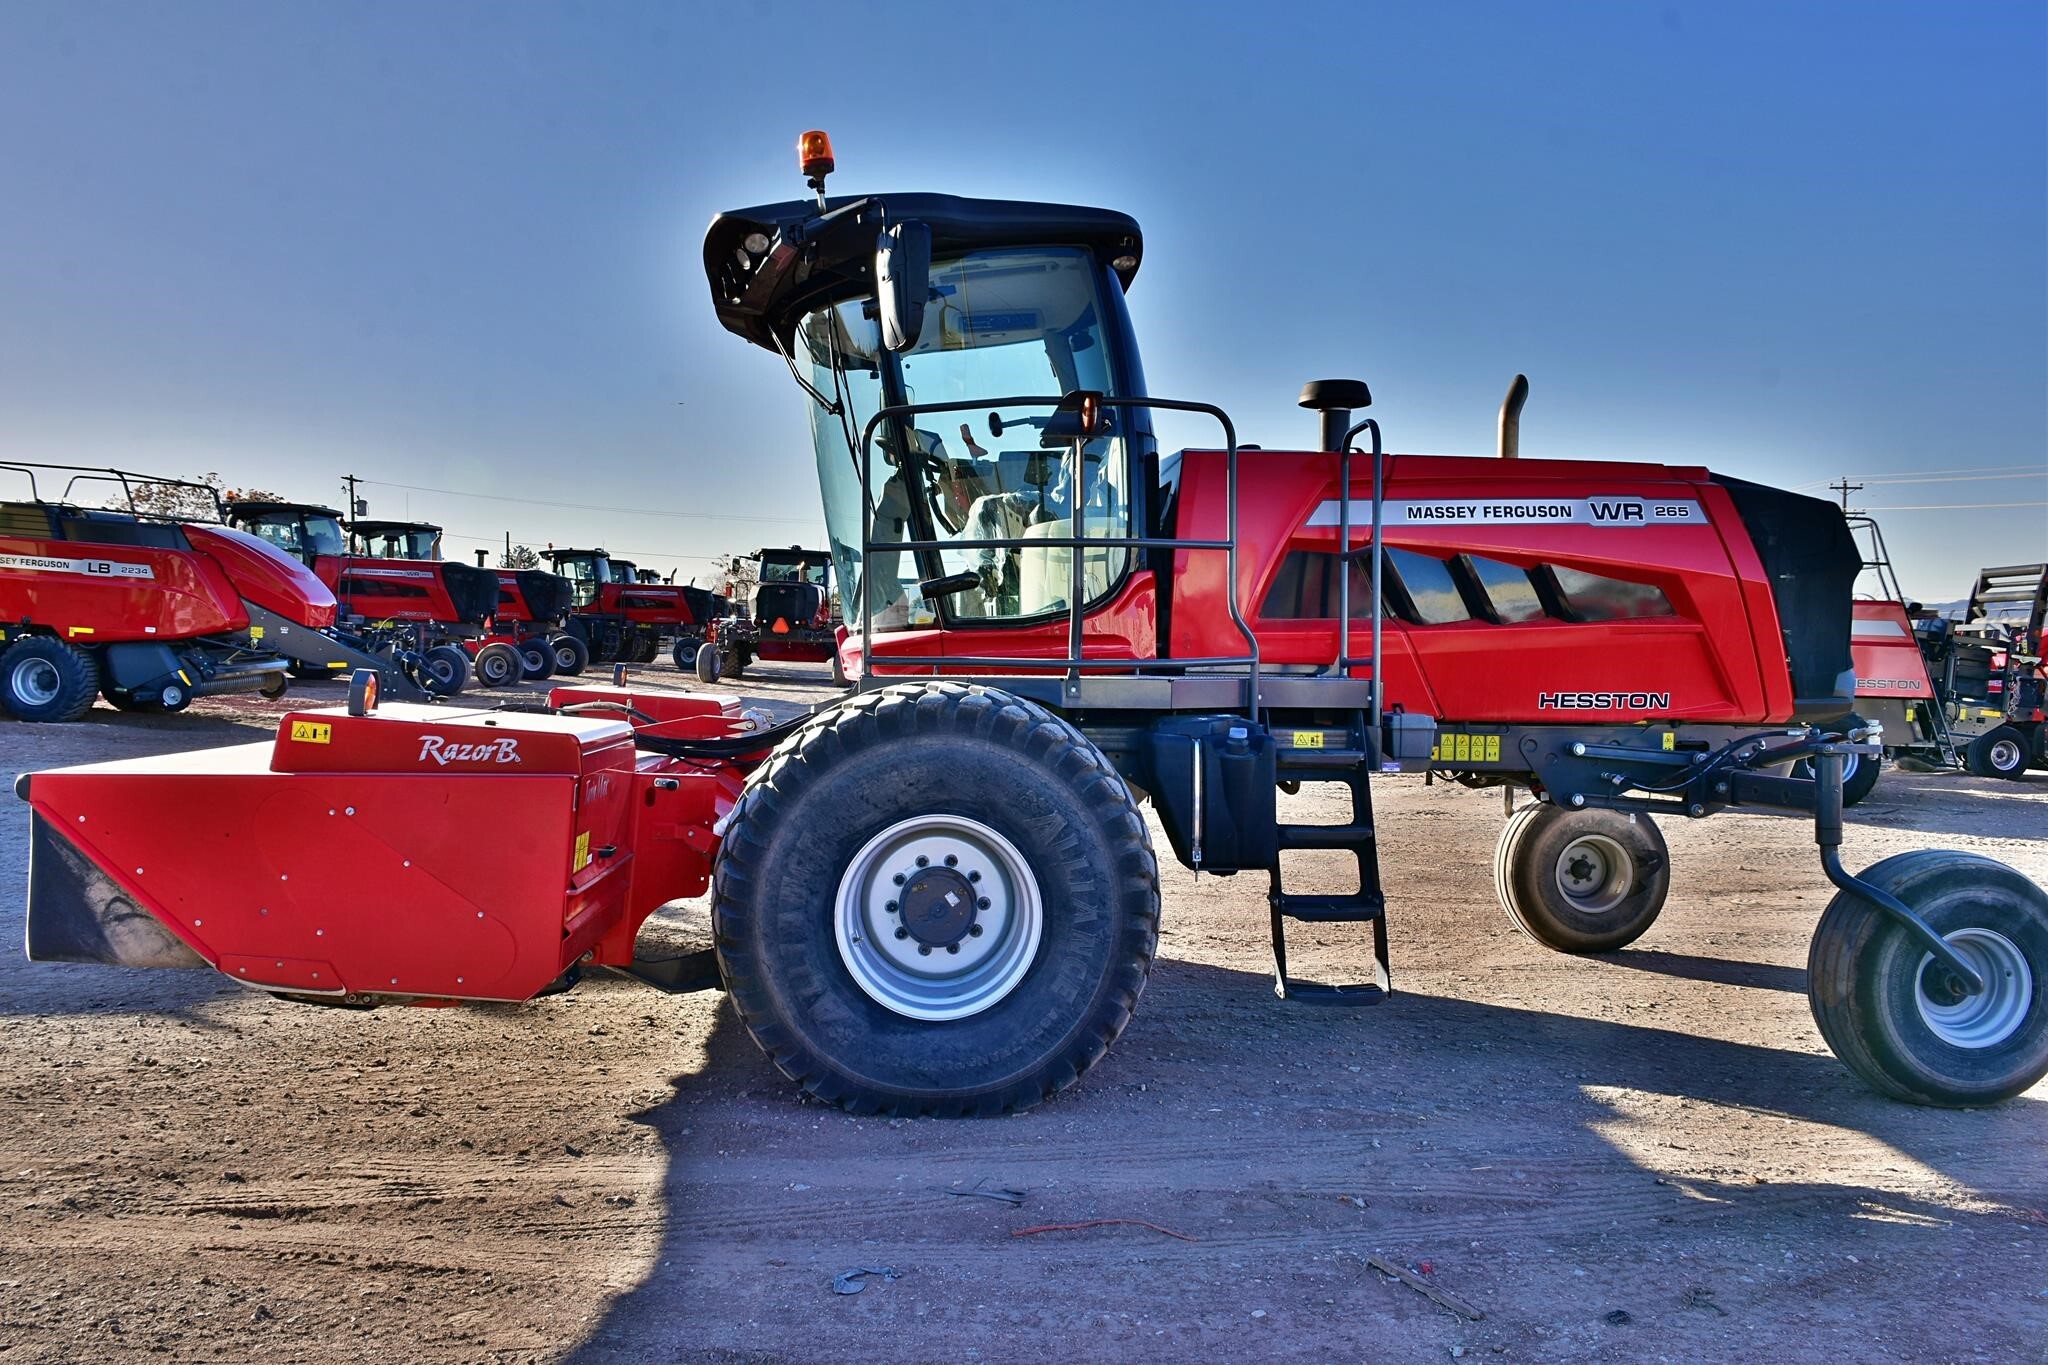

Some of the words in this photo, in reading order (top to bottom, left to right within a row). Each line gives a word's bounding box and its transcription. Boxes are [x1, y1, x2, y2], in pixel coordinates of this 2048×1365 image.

[1406, 505, 1477, 520] MASSEY
[1482, 504, 1573, 519] FERGUSON
[1589, 501, 1645, 521] WR
[1653, 505, 1690, 518] 265
[20, 558, 70, 569] FERGUSON
[87, 562, 111, 574] LB
[121, 566, 148, 575] 2234
[1855, 678, 1921, 690] ESSTON
[1538, 692, 1670, 710] HESSTON
